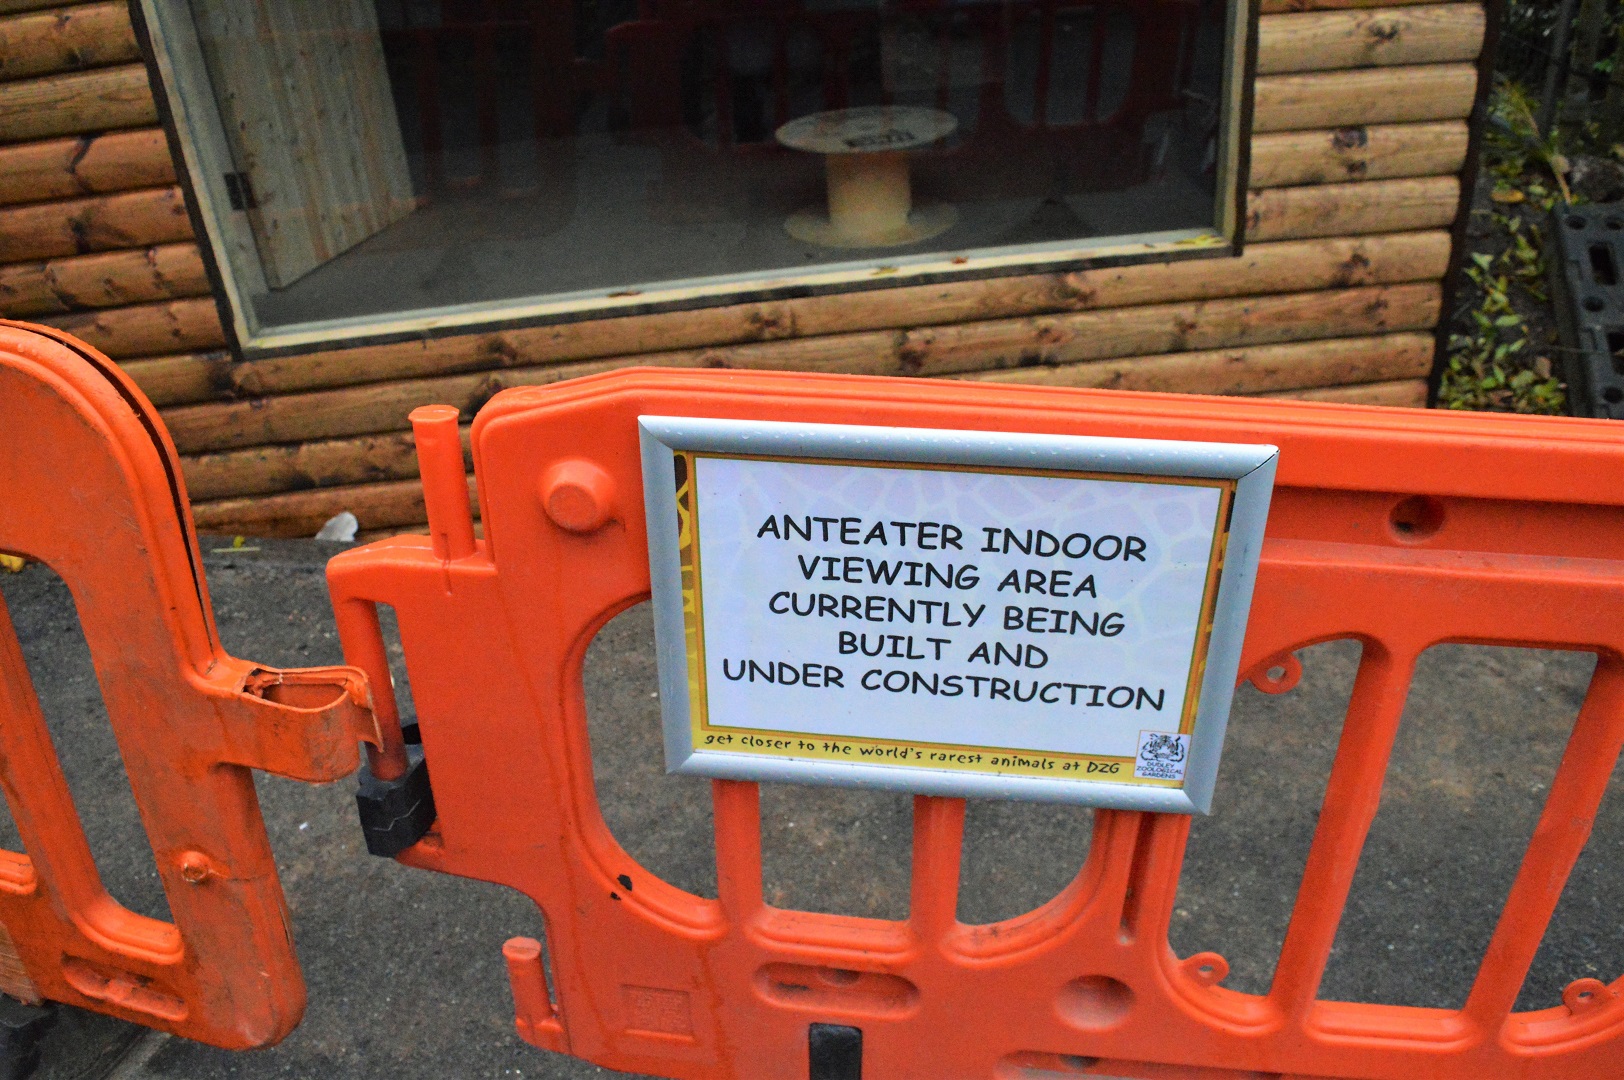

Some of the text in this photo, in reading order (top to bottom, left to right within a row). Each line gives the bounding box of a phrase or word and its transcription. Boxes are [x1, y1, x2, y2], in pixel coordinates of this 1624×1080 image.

[757, 515, 1146, 562] ANTEATER INDOOR
[798, 555, 1096, 598] VIEWING AREA
[768, 591, 1125, 637] CURRENTLY BEING
[839, 631, 1048, 668] BUILT AND
[722, 659, 1164, 711] UNDER CONSTRUCTION
[704, 734, 1121, 774] get closer to the world's rarest animals at DZG
[1136, 766, 1183, 774] ZOOLOGICAL
[1141, 770, 1176, 779] GARDENS
